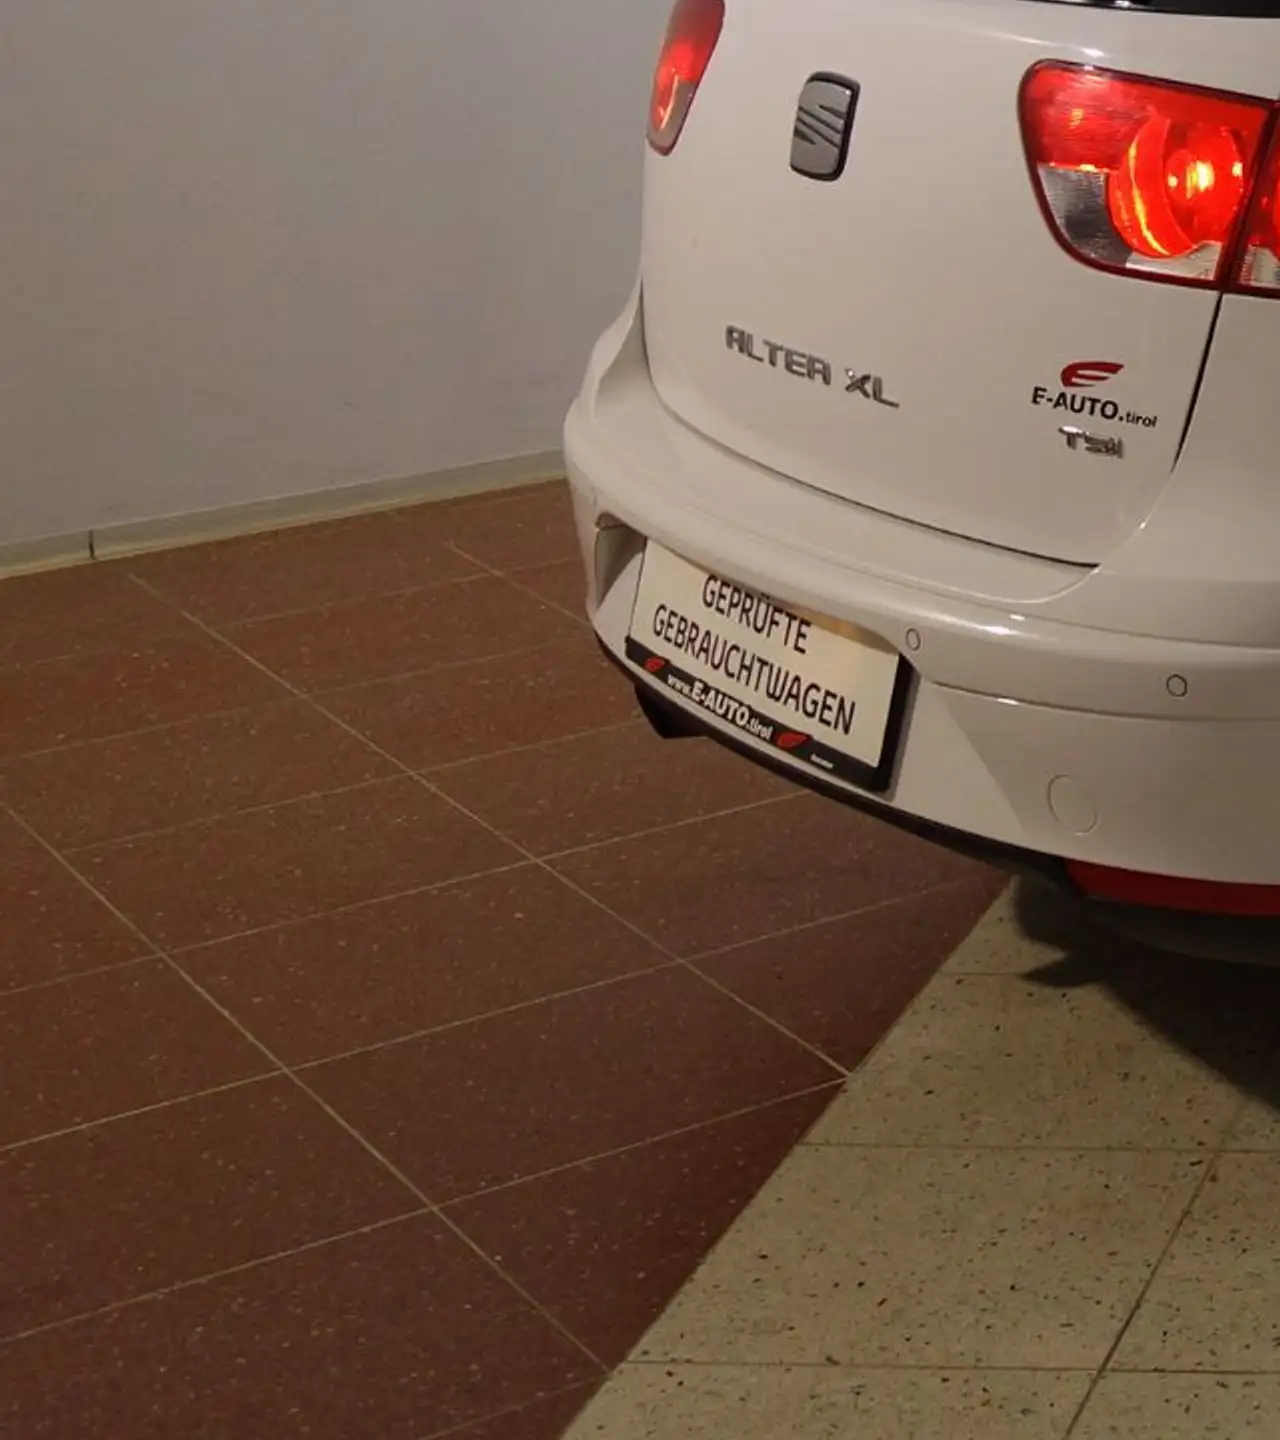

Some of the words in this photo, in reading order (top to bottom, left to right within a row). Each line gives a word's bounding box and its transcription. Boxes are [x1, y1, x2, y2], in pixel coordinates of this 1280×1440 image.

[844, 367, 900, 409] XL
[1031, 385, 1158, 428] E-AUTO.tirol
[703, 574, 812, 655] GEPRÜFTE
[653, 603, 856, 736] GEBRAUCHTWAGEN
